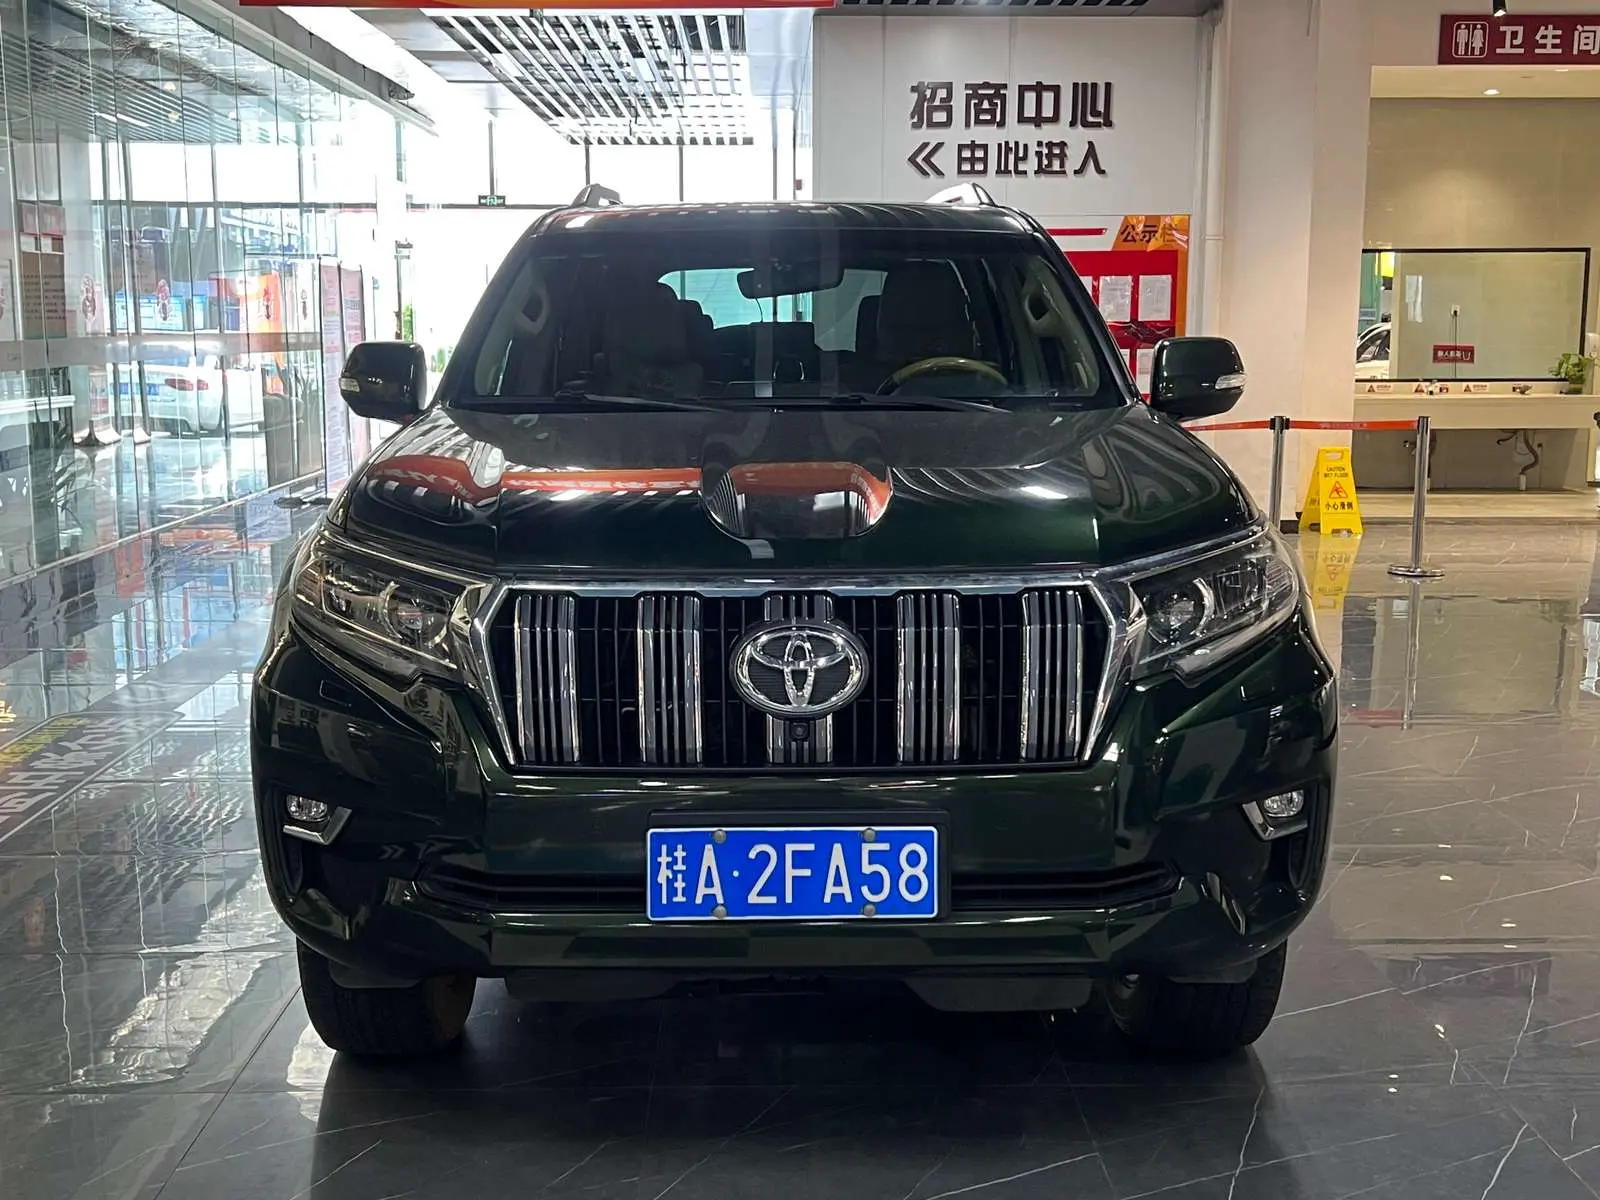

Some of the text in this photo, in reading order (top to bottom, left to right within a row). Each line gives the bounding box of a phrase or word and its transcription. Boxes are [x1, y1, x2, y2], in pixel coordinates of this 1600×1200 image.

[1495, 24, 1600, 55] 卫生间
[910, 81, 1114, 129] 招商中心
[956, 140, 1107, 177] 由此进入
